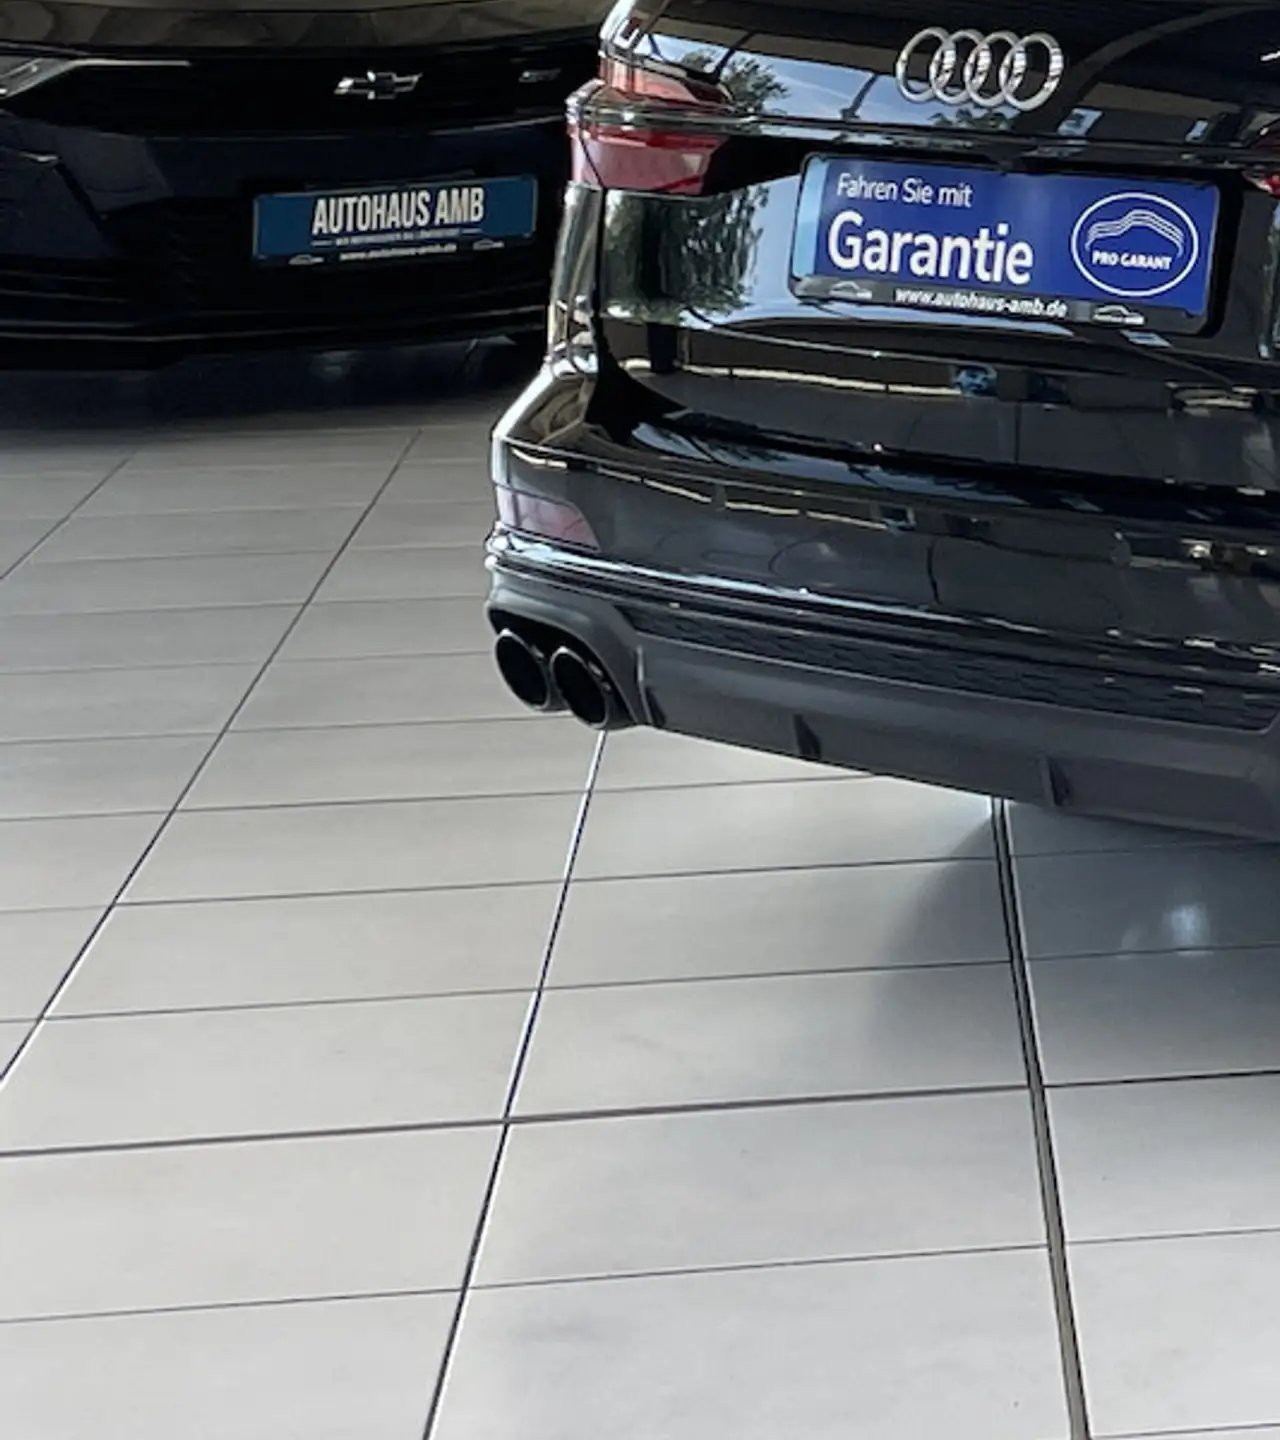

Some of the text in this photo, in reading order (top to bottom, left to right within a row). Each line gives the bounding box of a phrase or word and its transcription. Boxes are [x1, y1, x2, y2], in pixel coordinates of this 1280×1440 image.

[836, 172, 973, 209] Fahren Sie mit
[311, 187, 486, 236] AUTOHAUS AMB
[827, 210, 1035, 285] Garantie
[1091, 250, 1173, 271] PRO GARANT
[894, 287, 1068, 319] www.autohaus-amb.de
